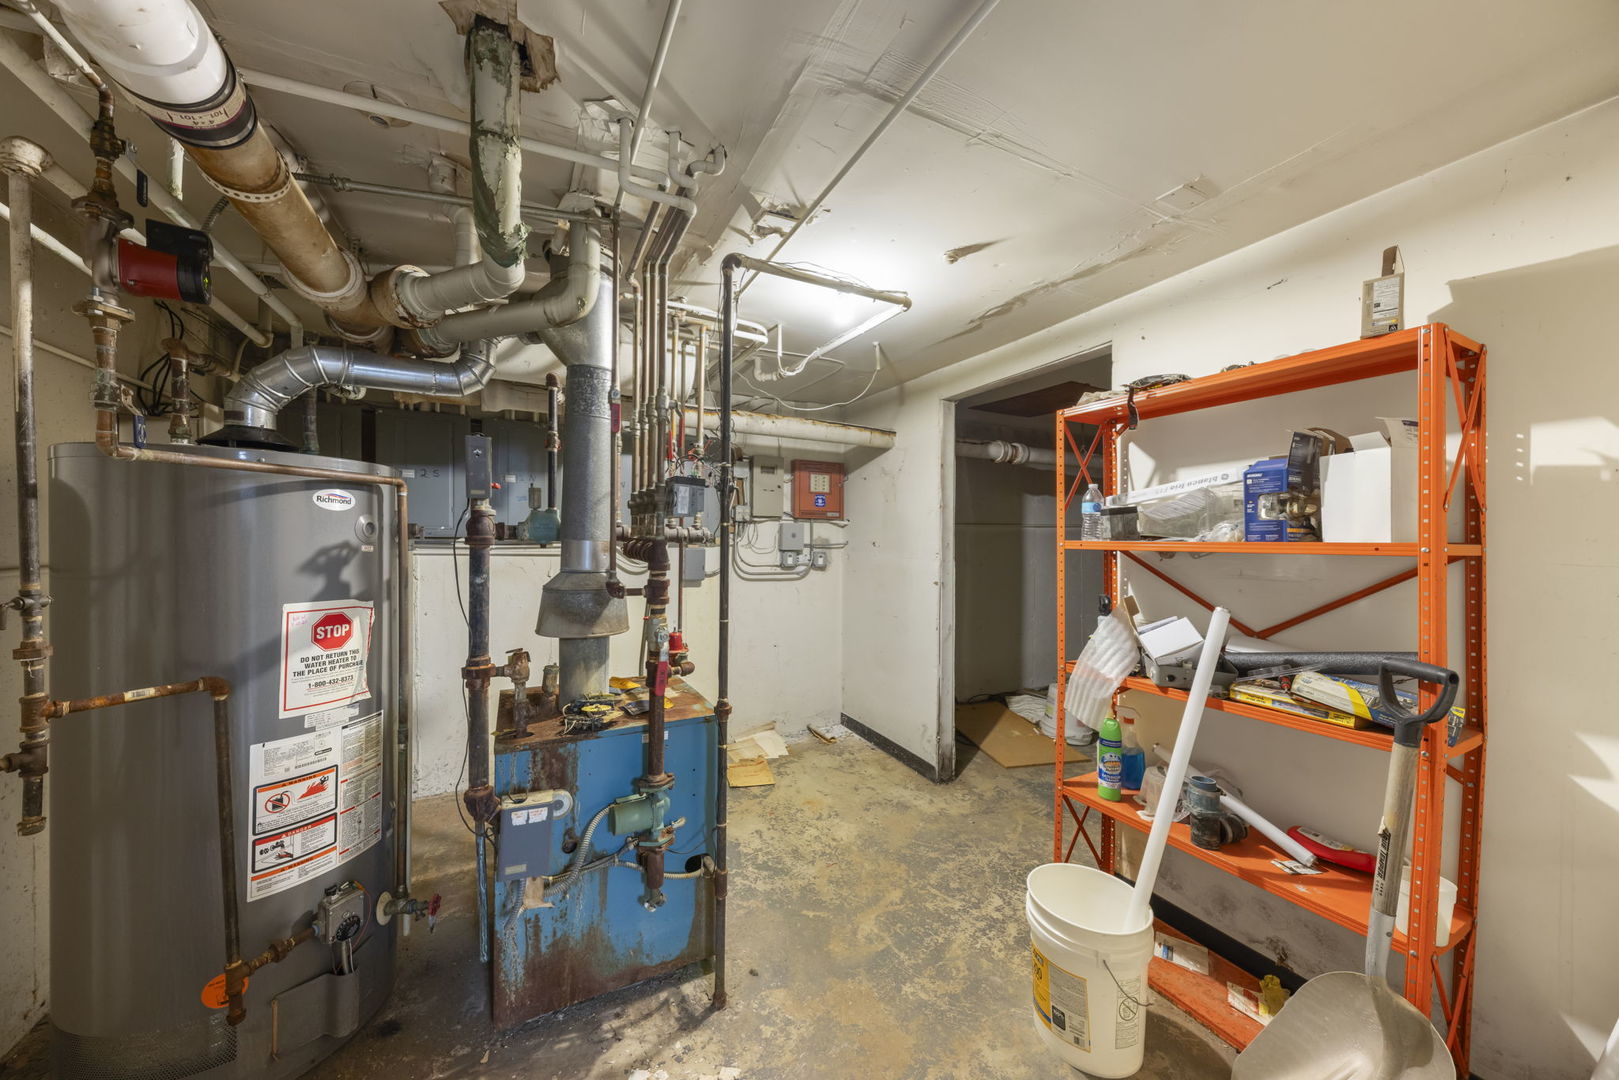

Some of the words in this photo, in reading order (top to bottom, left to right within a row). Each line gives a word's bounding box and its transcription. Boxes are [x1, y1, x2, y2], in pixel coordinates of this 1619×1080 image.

[316, 495, 352, 505] Richmond
[316, 624, 350, 640] STOP
[300, 656, 310, 664] DO
[311, 654, 324, 662] NOT
[325, 651, 348, 660] RETURN
[349, 648, 360, 656] THIS
[304, 660, 327, 670] WATER
[327, 657, 350, 666] HEATER
[307, 667, 328, 676] PLACE
[1377, 849, 1388, 880] TEMPER
